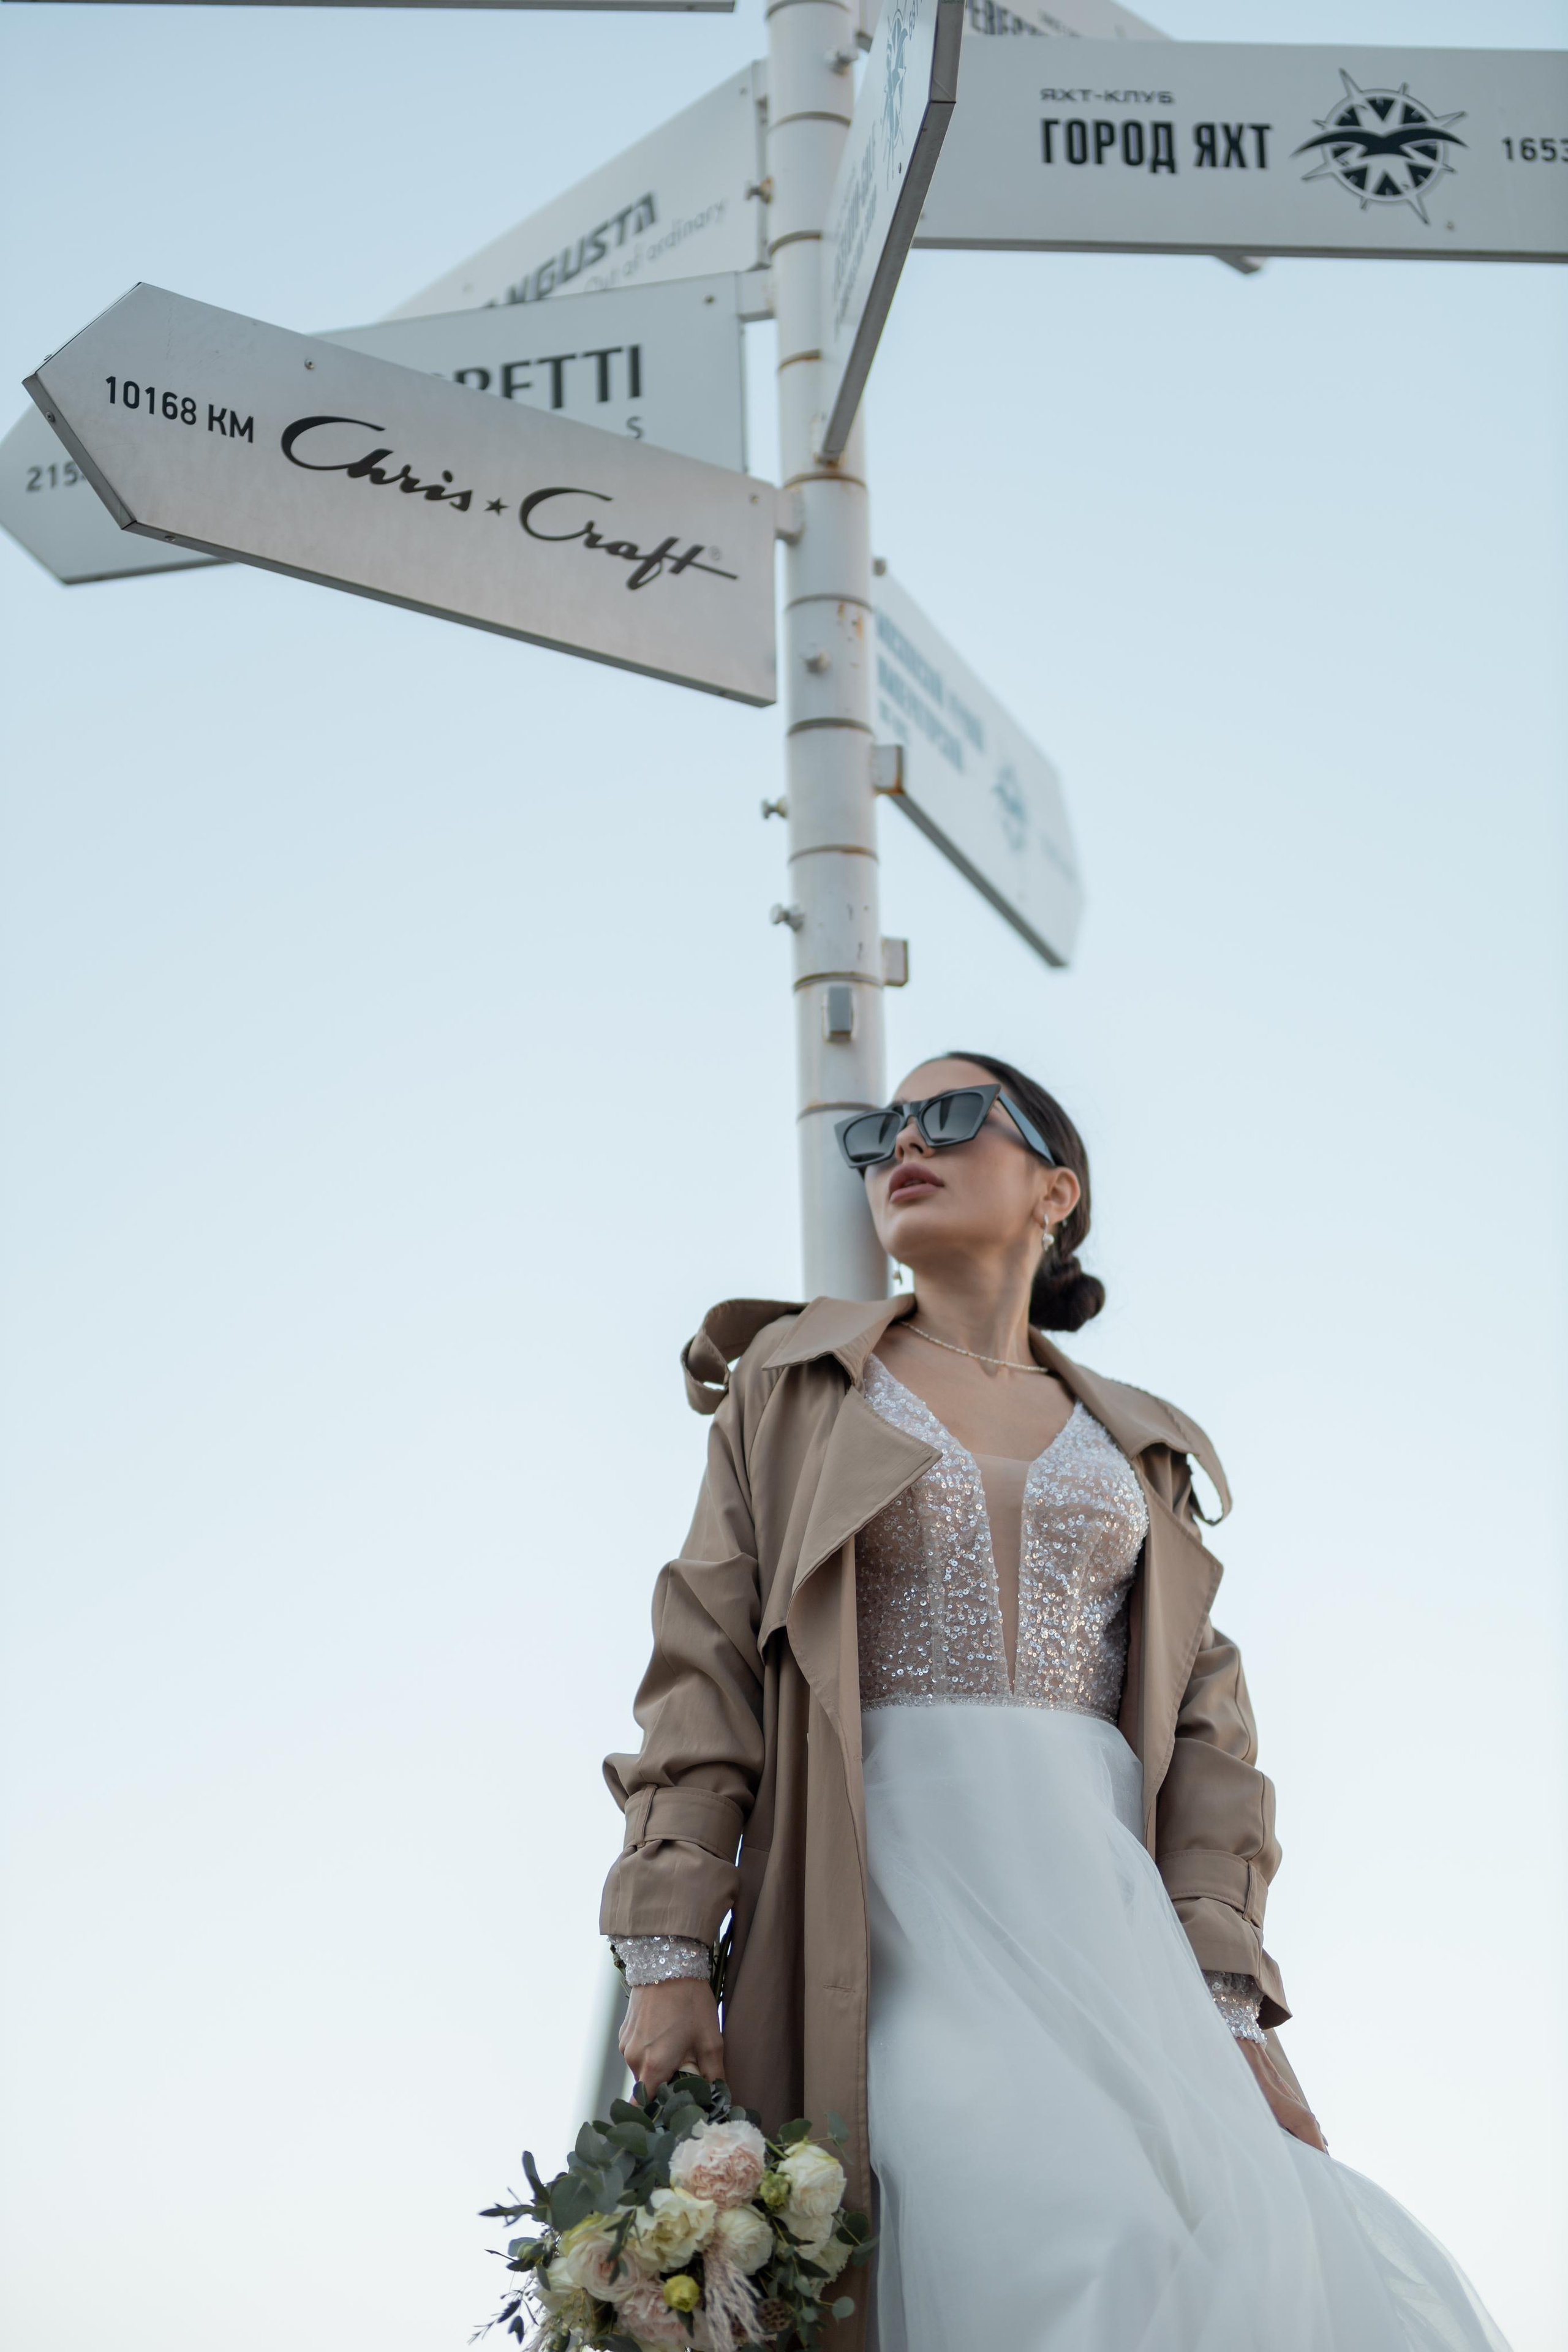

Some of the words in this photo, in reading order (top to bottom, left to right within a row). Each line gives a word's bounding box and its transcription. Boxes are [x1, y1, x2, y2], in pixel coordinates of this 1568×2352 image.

[1041, 88, 1175, 104] ЯХТ-КЛУБ
[1042, 118, 1177, 174] ГОРОД
[1193, 122, 1273, 168] ЯХТ
[105, 375, 197, 425] 10168
[281, 415, 472, 511] Chris
[519, 487, 738, 590] Craft
